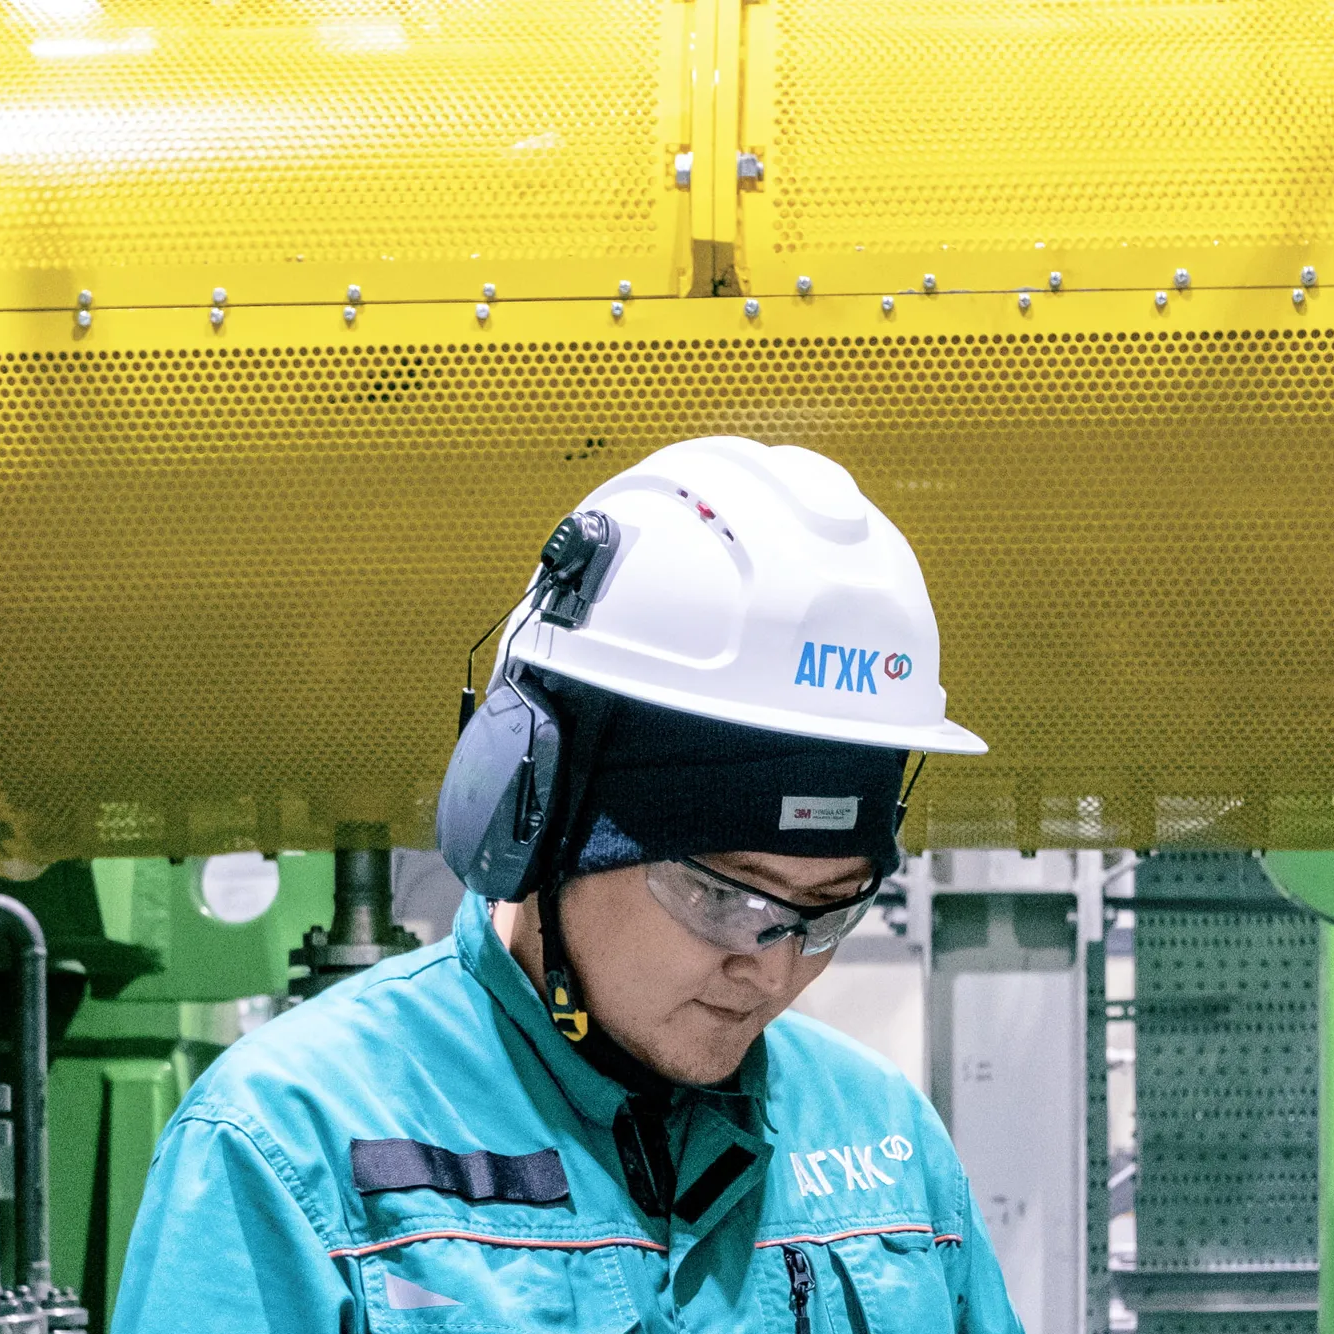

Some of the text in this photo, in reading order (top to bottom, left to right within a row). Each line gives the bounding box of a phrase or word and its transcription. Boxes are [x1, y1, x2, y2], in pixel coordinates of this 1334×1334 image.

[794, 641, 880, 695] АГХК
[794, 808, 812, 819] 3M
[789, 1145, 895, 1197] АГХК
